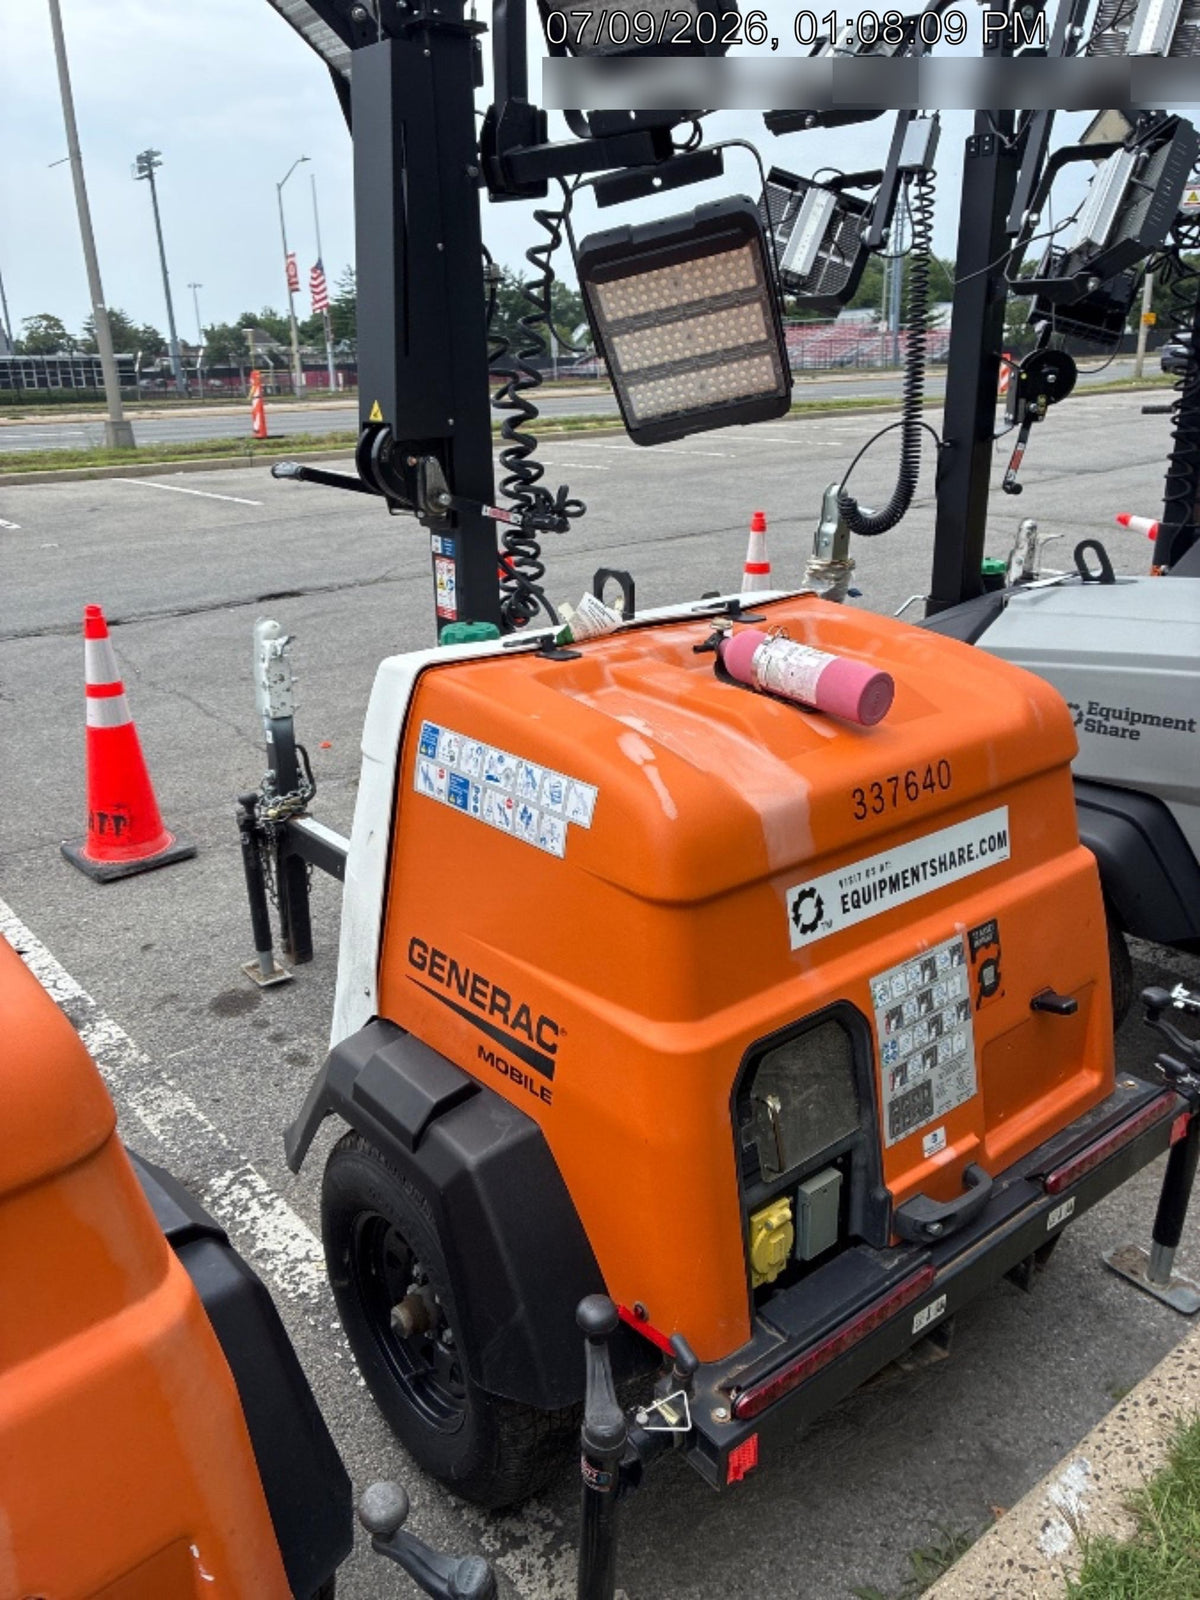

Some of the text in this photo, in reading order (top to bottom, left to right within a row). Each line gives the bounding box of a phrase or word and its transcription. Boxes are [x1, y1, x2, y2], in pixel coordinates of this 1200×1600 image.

[1084, 717, 1141, 741] Share
[1087, 700, 1197, 733] Equipment
[853, 759, 952, 820] 337640
[840, 829, 1008, 914] EQUIPMENTSHARE.COM
[407, 936, 560, 1055] GENERAC
[477, 1044, 553, 1106] MOBILE
